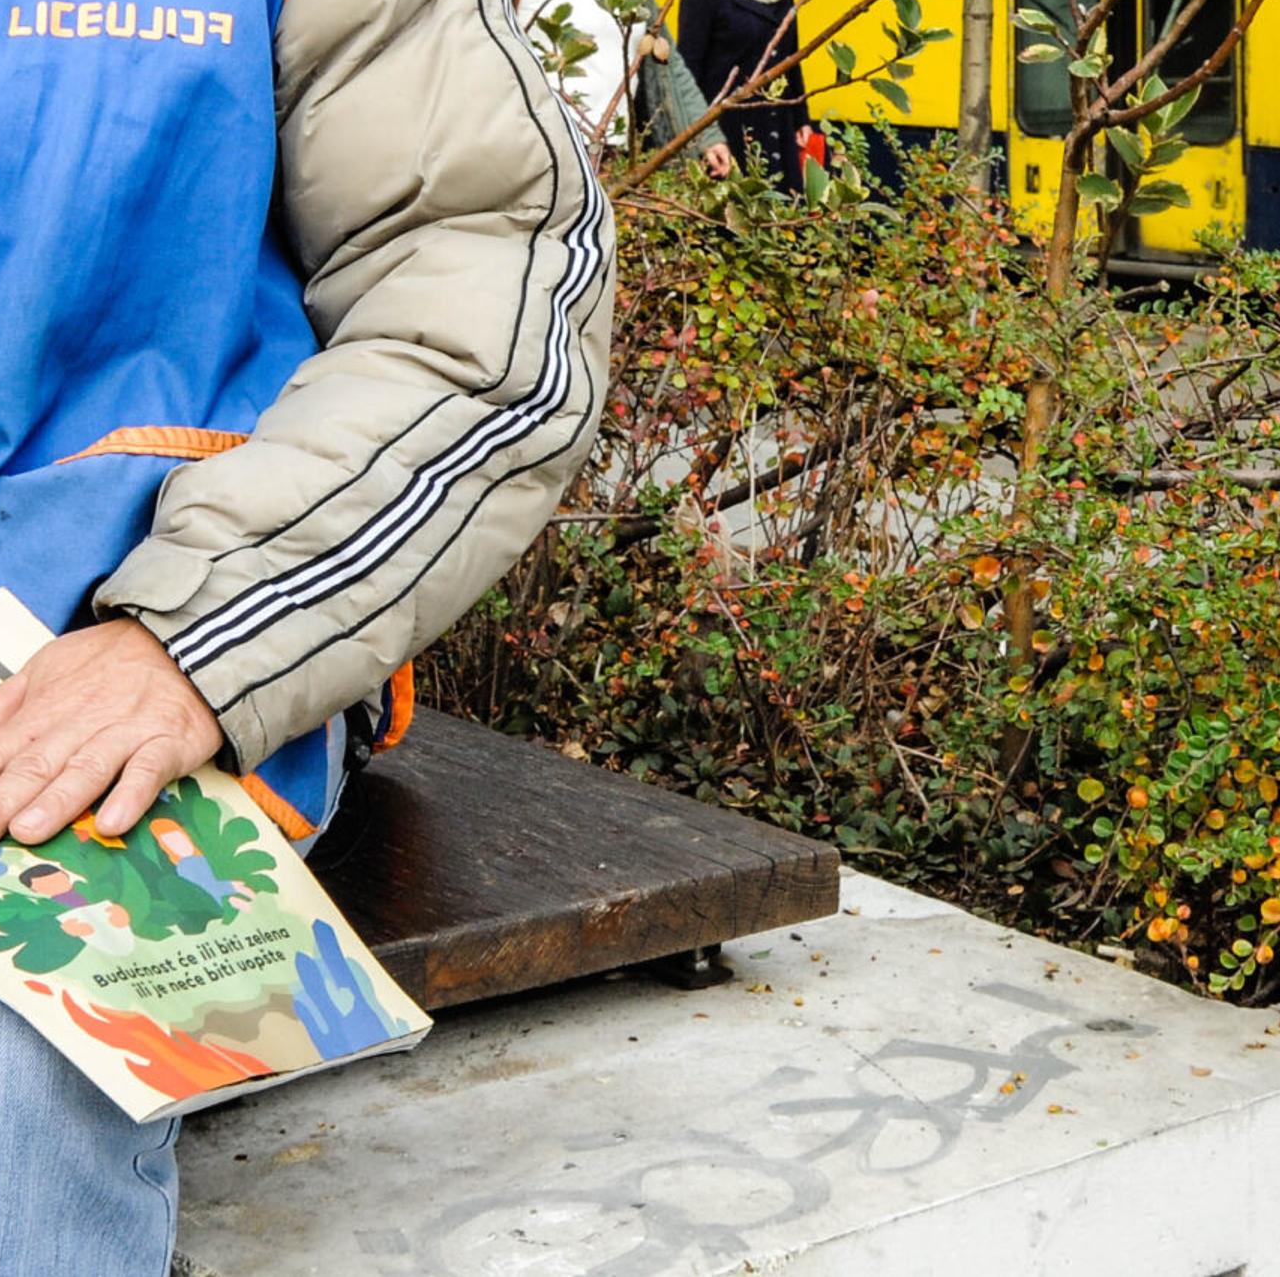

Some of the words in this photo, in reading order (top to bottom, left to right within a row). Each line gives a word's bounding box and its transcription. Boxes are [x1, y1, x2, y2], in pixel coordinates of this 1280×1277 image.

[93, 959, 177, 988] Budućnost
[177, 950, 198, 968] će
[196, 941, 216, 961] ili
[214, 933, 244, 955] biti
[245, 927, 291, 947] zelena
[131, 980, 152, 998] ili
[148, 980, 168, 998] je
[169, 971, 206, 992] neće
[203, 958, 236, 982] biti
[236, 948, 287, 971] uopšte
